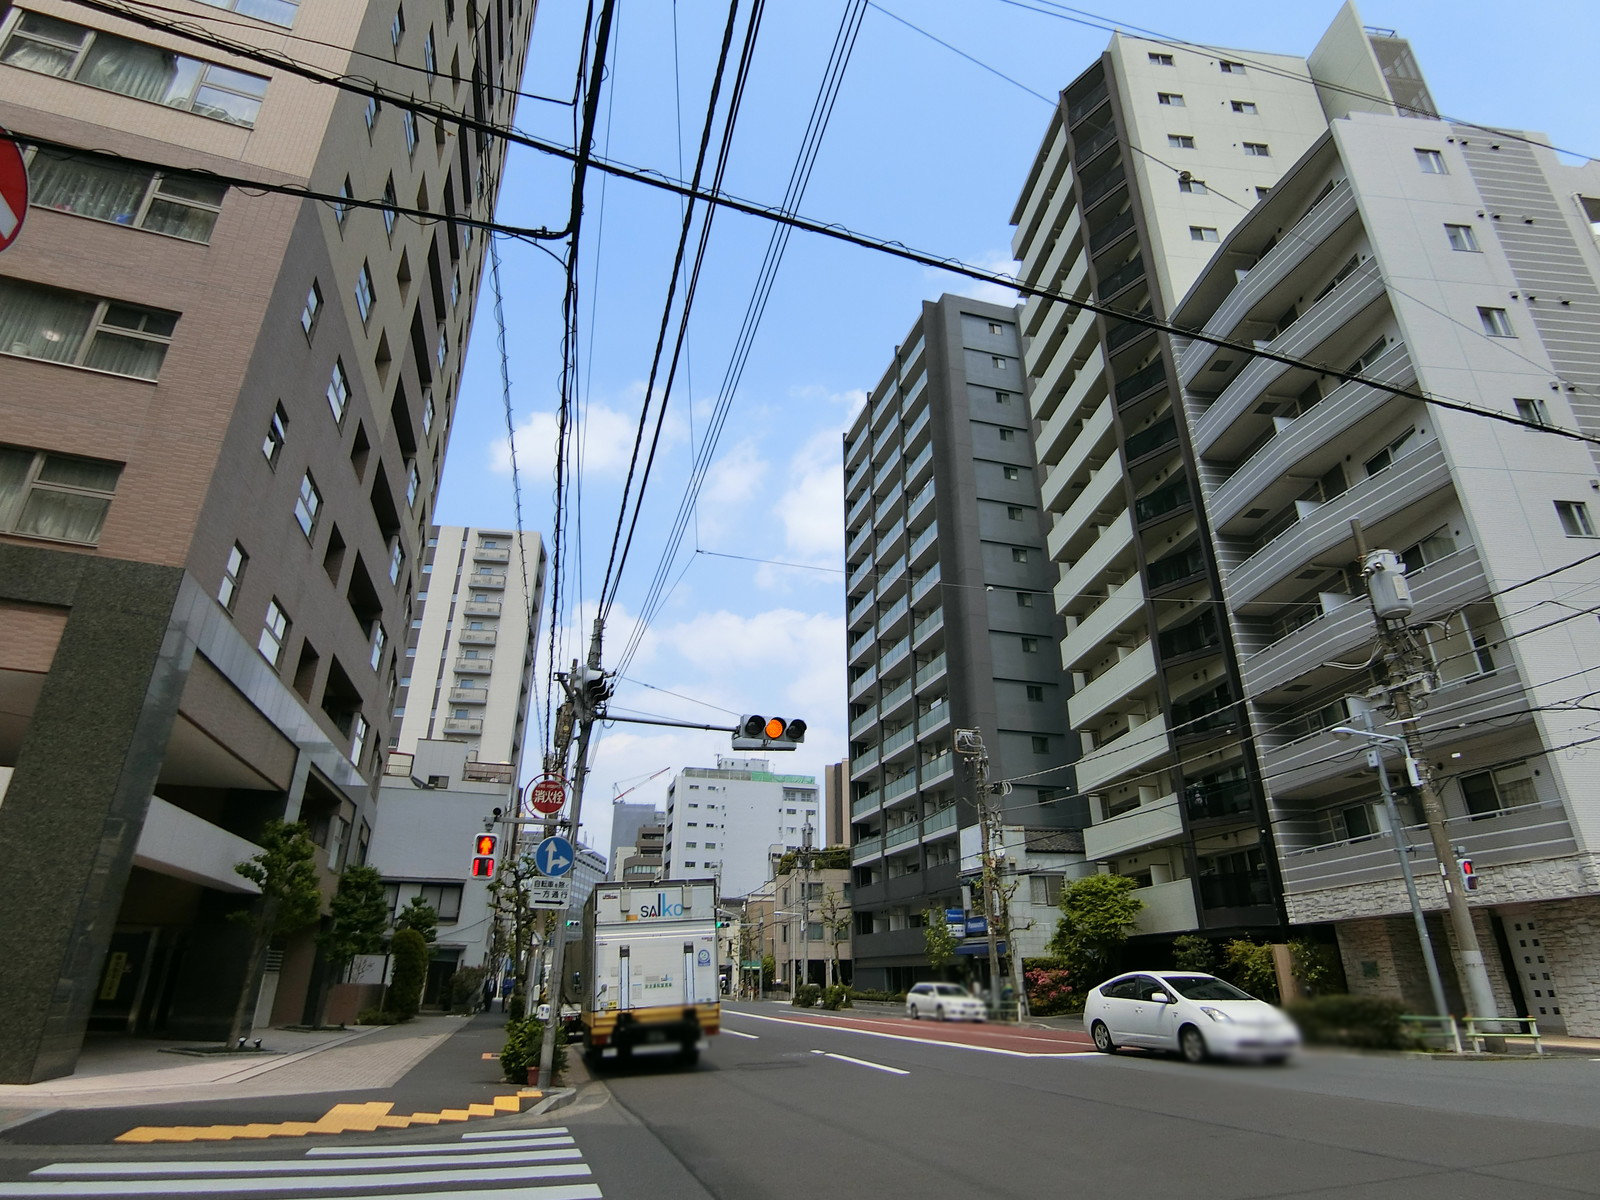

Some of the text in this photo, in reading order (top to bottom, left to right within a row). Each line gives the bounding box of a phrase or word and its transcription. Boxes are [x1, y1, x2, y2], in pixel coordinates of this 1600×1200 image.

[534, 790, 564, 804] 消火栓
[534, 880, 569, 888] 自転車を除く
[534, 890, 568, 899] 一方通行
